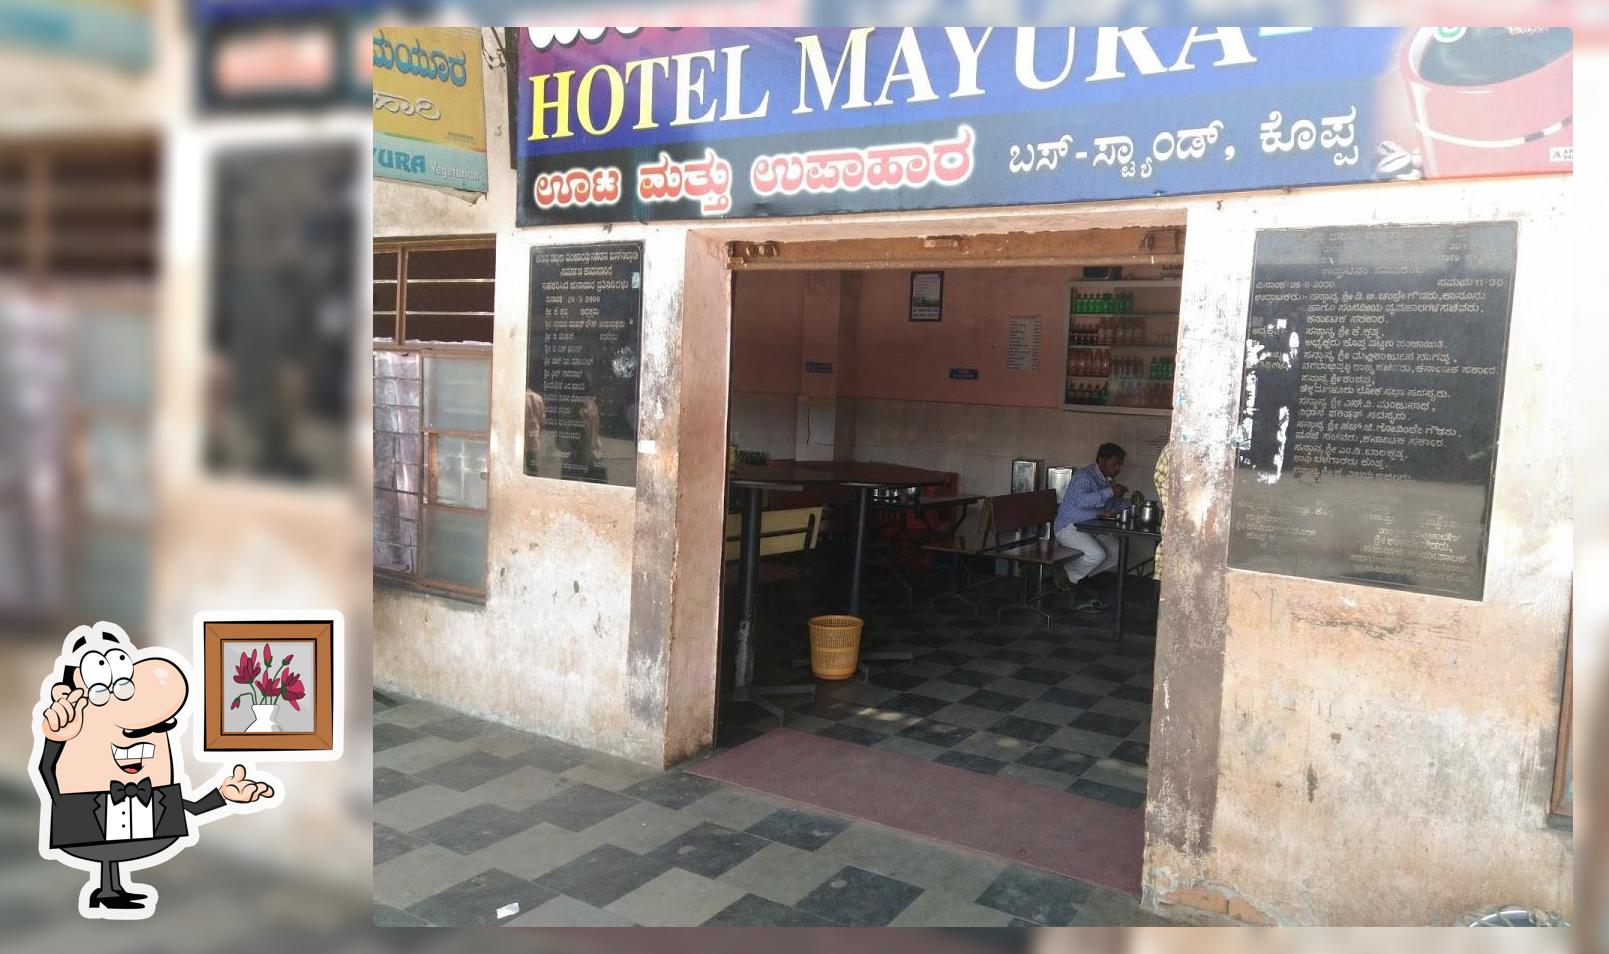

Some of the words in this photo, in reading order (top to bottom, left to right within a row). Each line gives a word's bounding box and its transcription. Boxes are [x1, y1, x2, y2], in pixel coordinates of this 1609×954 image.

[527, 44, 769, 142] HOTEL
[793, 27, 1258, 115] MAYURA
[373, 147, 426, 174] URA
[533, 166, 621, 210] ಊಟ
[636, 149, 734, 215] ಮತ್ತು
[750, 124, 976, 198] ಉಪಾಹಾರ
[1259, 105, 1359, 168] ಕೊಪ್ಪ
